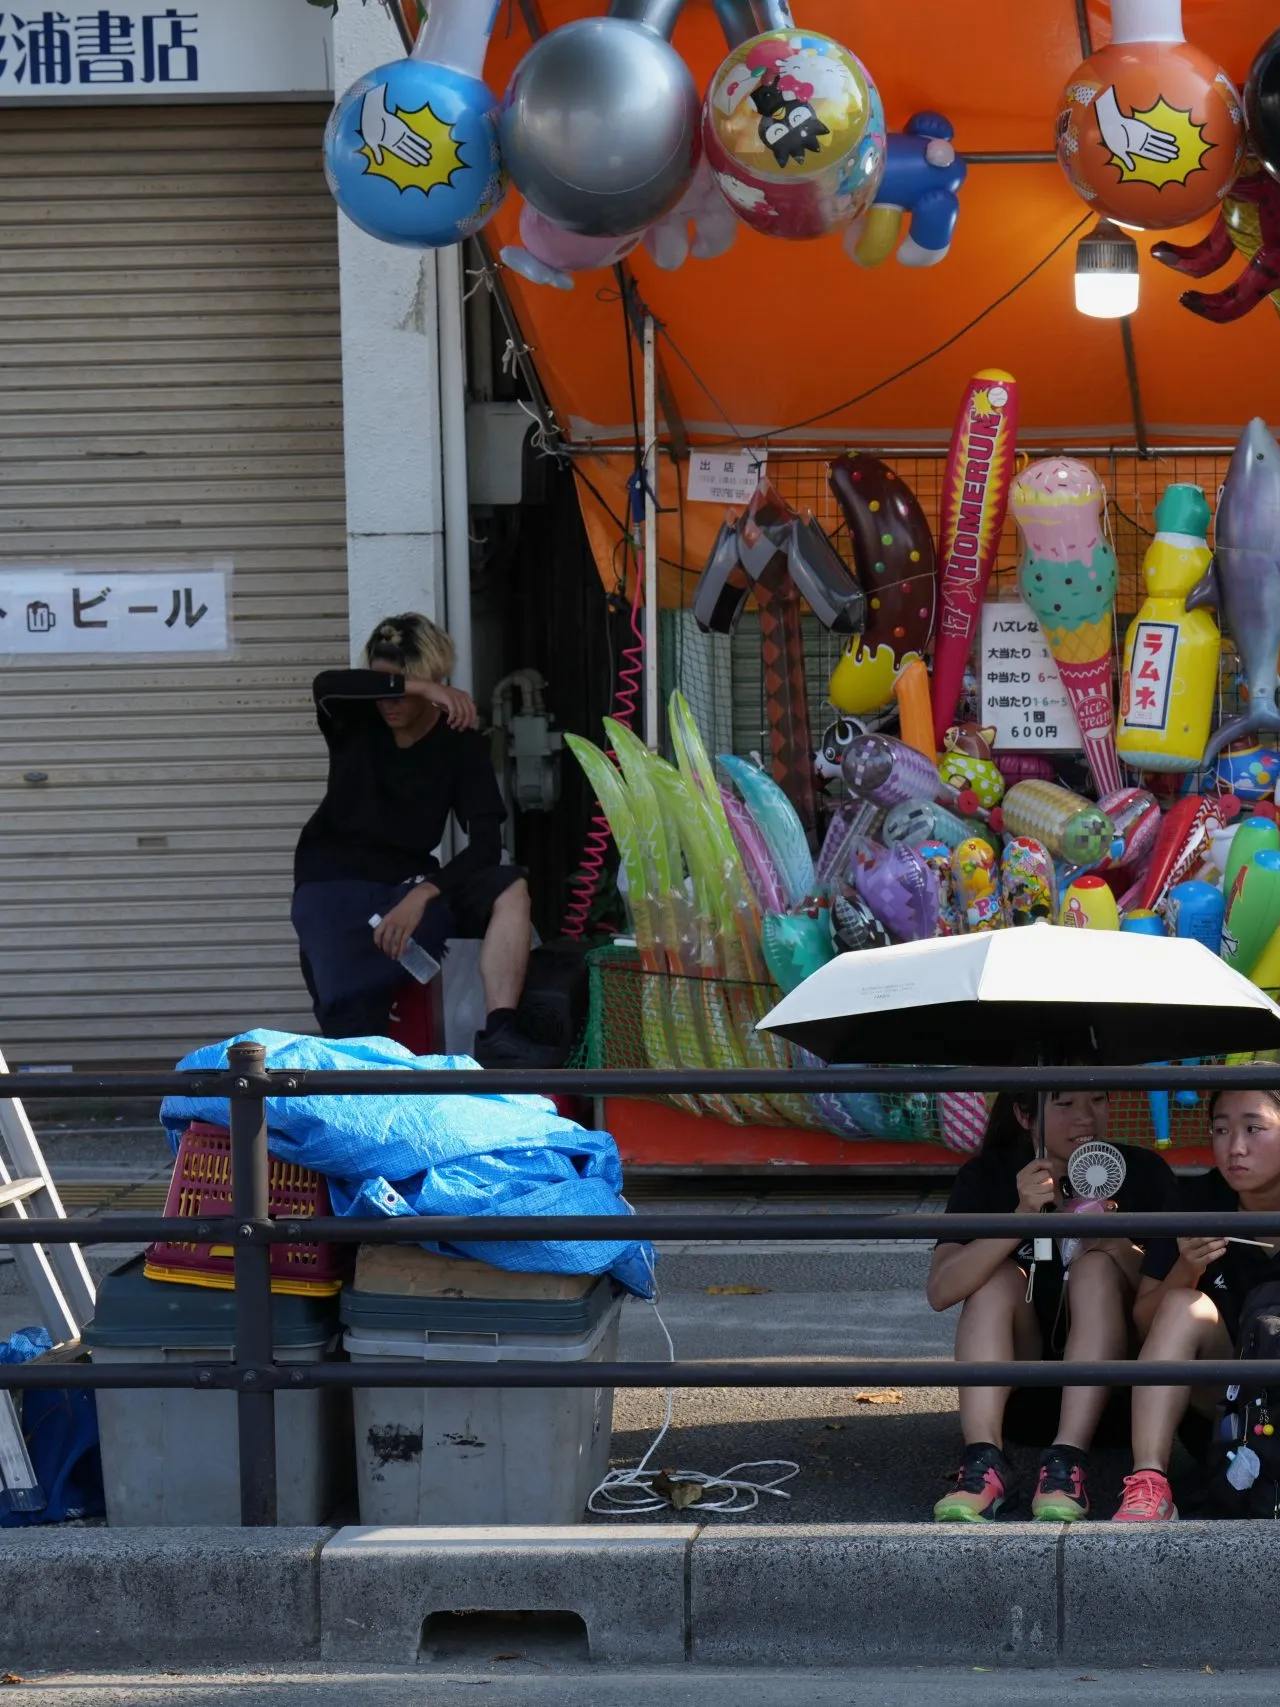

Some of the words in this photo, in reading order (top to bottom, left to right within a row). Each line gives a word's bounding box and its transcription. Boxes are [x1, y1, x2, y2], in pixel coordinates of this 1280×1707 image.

[0, 9, 199, 84] 浦書店
[946, 408, 1003, 581] HOMERUN
[72, 587, 209, 628] ビール
[988, 648, 1031, 659] 大当たり
[987, 672, 1031, 684] 中当たり
[1134, 633, 1164, 710] ラムネ
[987, 696, 1031, 708] 小当たり
[1084, 701, 1103, 716] ice
[1023, 711, 1046, 723] 1回
[1011, 726, 1058, 738] 600円
